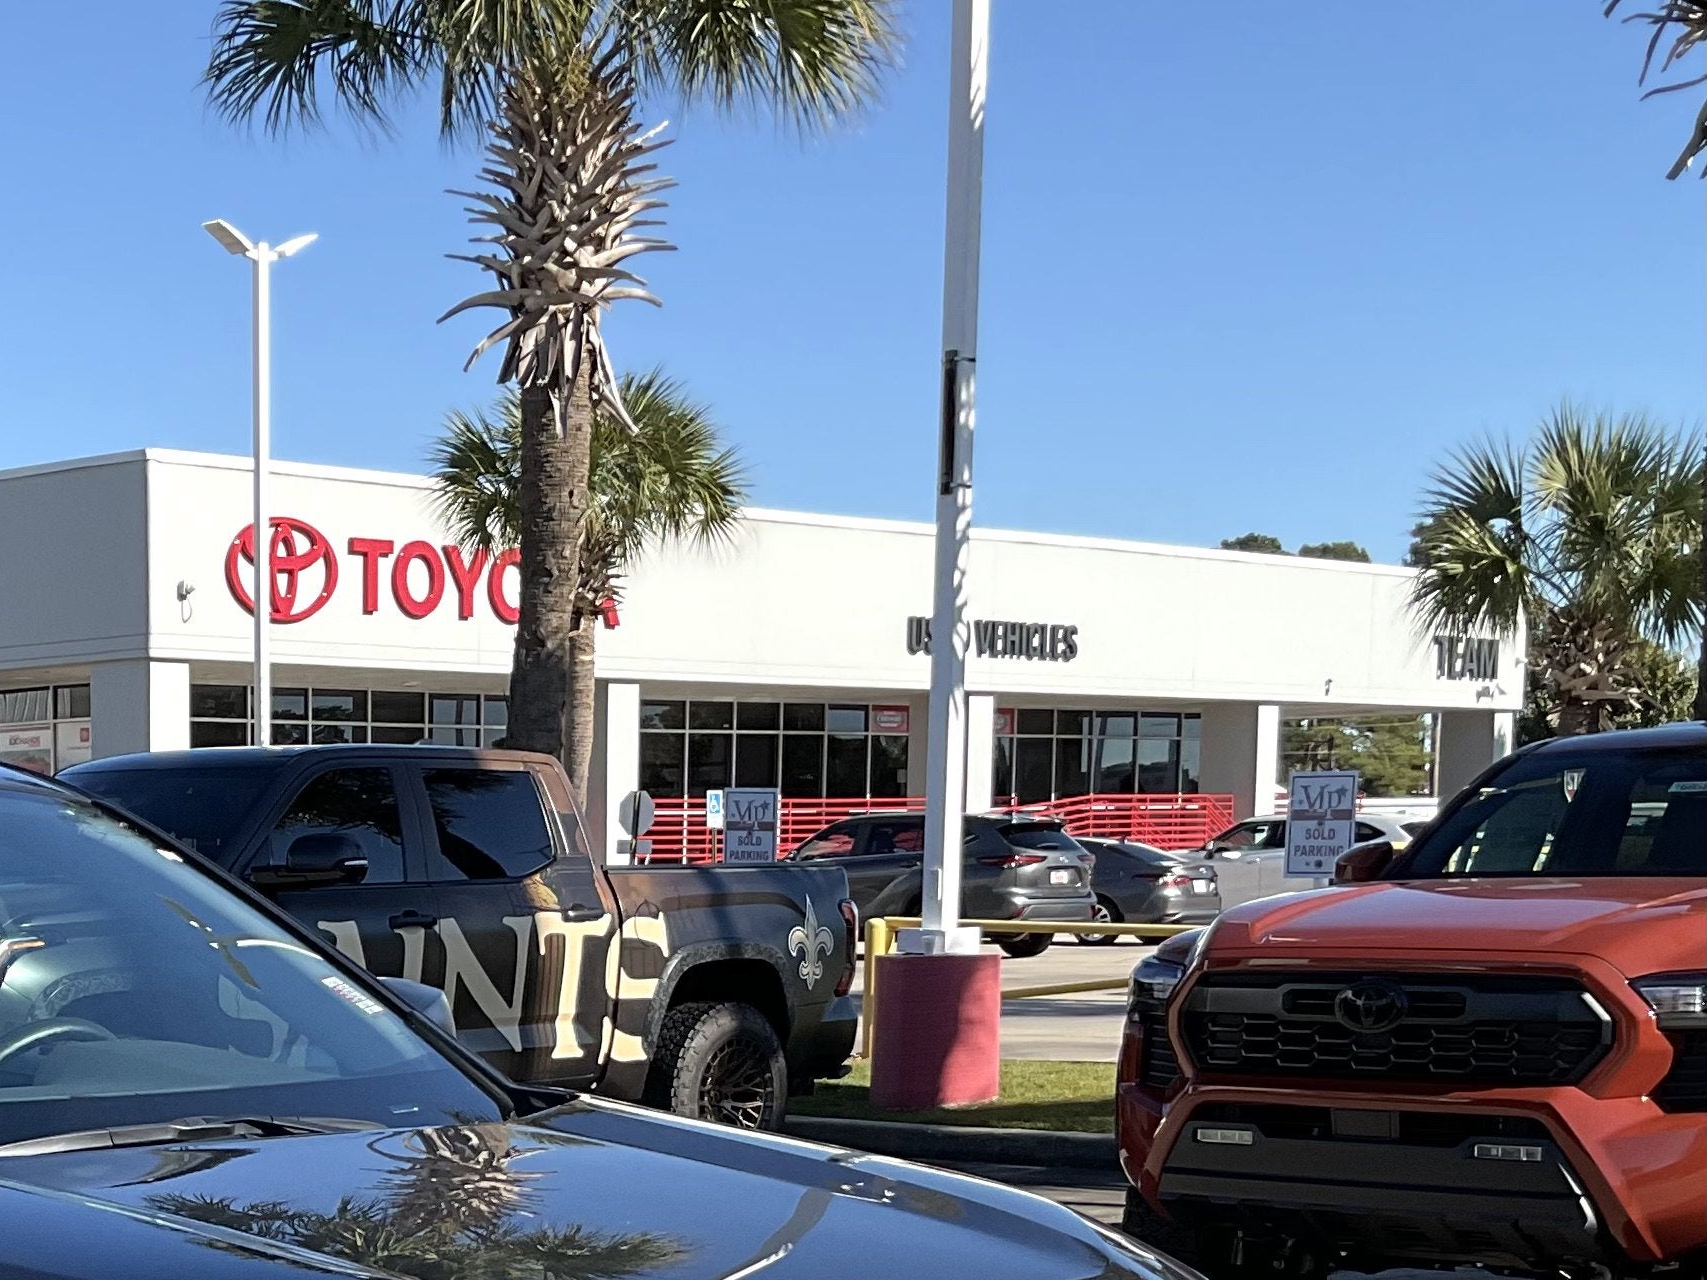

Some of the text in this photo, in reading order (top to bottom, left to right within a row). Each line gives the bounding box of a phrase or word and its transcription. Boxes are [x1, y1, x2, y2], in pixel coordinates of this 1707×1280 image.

[348, 537, 621, 630] TOYO
[974, 619, 1078, 662] VEHICLES
[1432, 635, 1500, 681] TEAM
[1305, 828, 1336, 841] SOLD
[737, 836, 762, 847] SOLD
[729, 850, 769, 861] PARKING
[1293, 845, 1344, 857] PARKING
